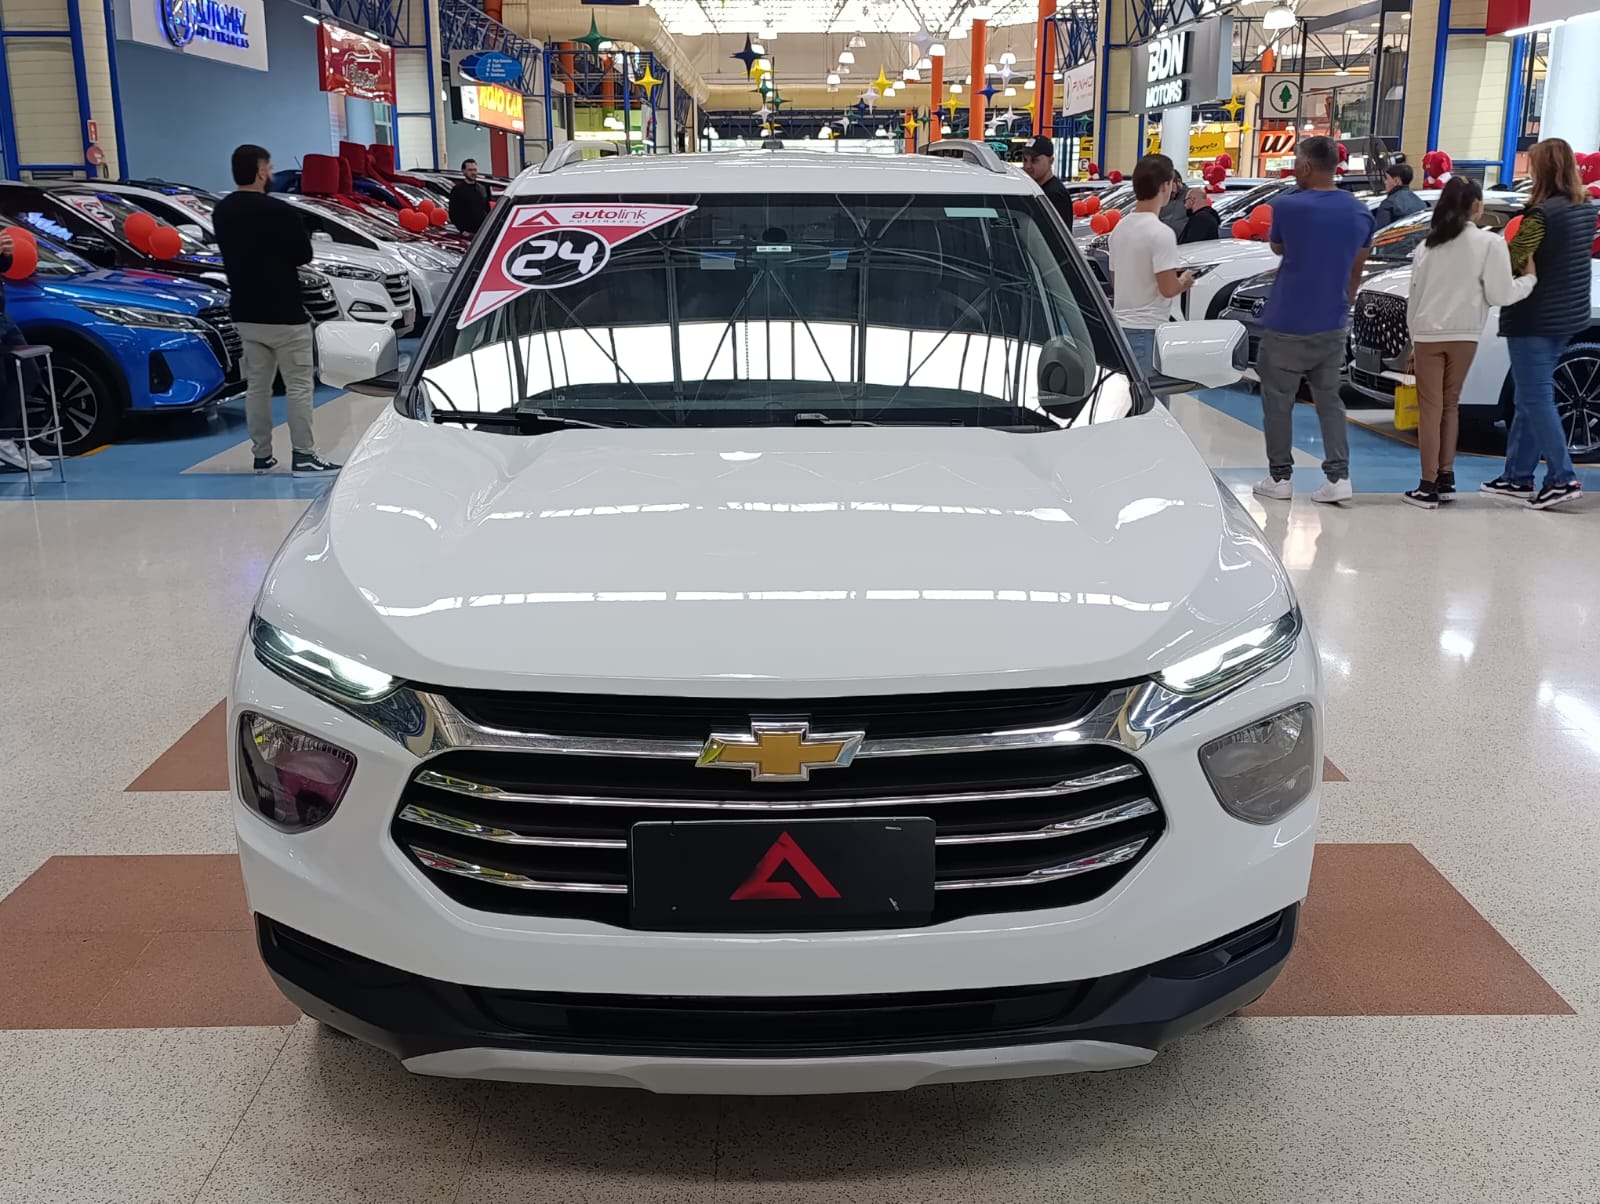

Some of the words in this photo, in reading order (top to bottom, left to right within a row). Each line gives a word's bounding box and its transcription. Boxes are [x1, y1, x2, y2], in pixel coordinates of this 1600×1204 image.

[1147, 31, 1185, 83] BDN
[1145, 79, 1183, 108] MOTORS
[571, 209, 648, 219] autolink
[511, 239, 599, 277] 24
